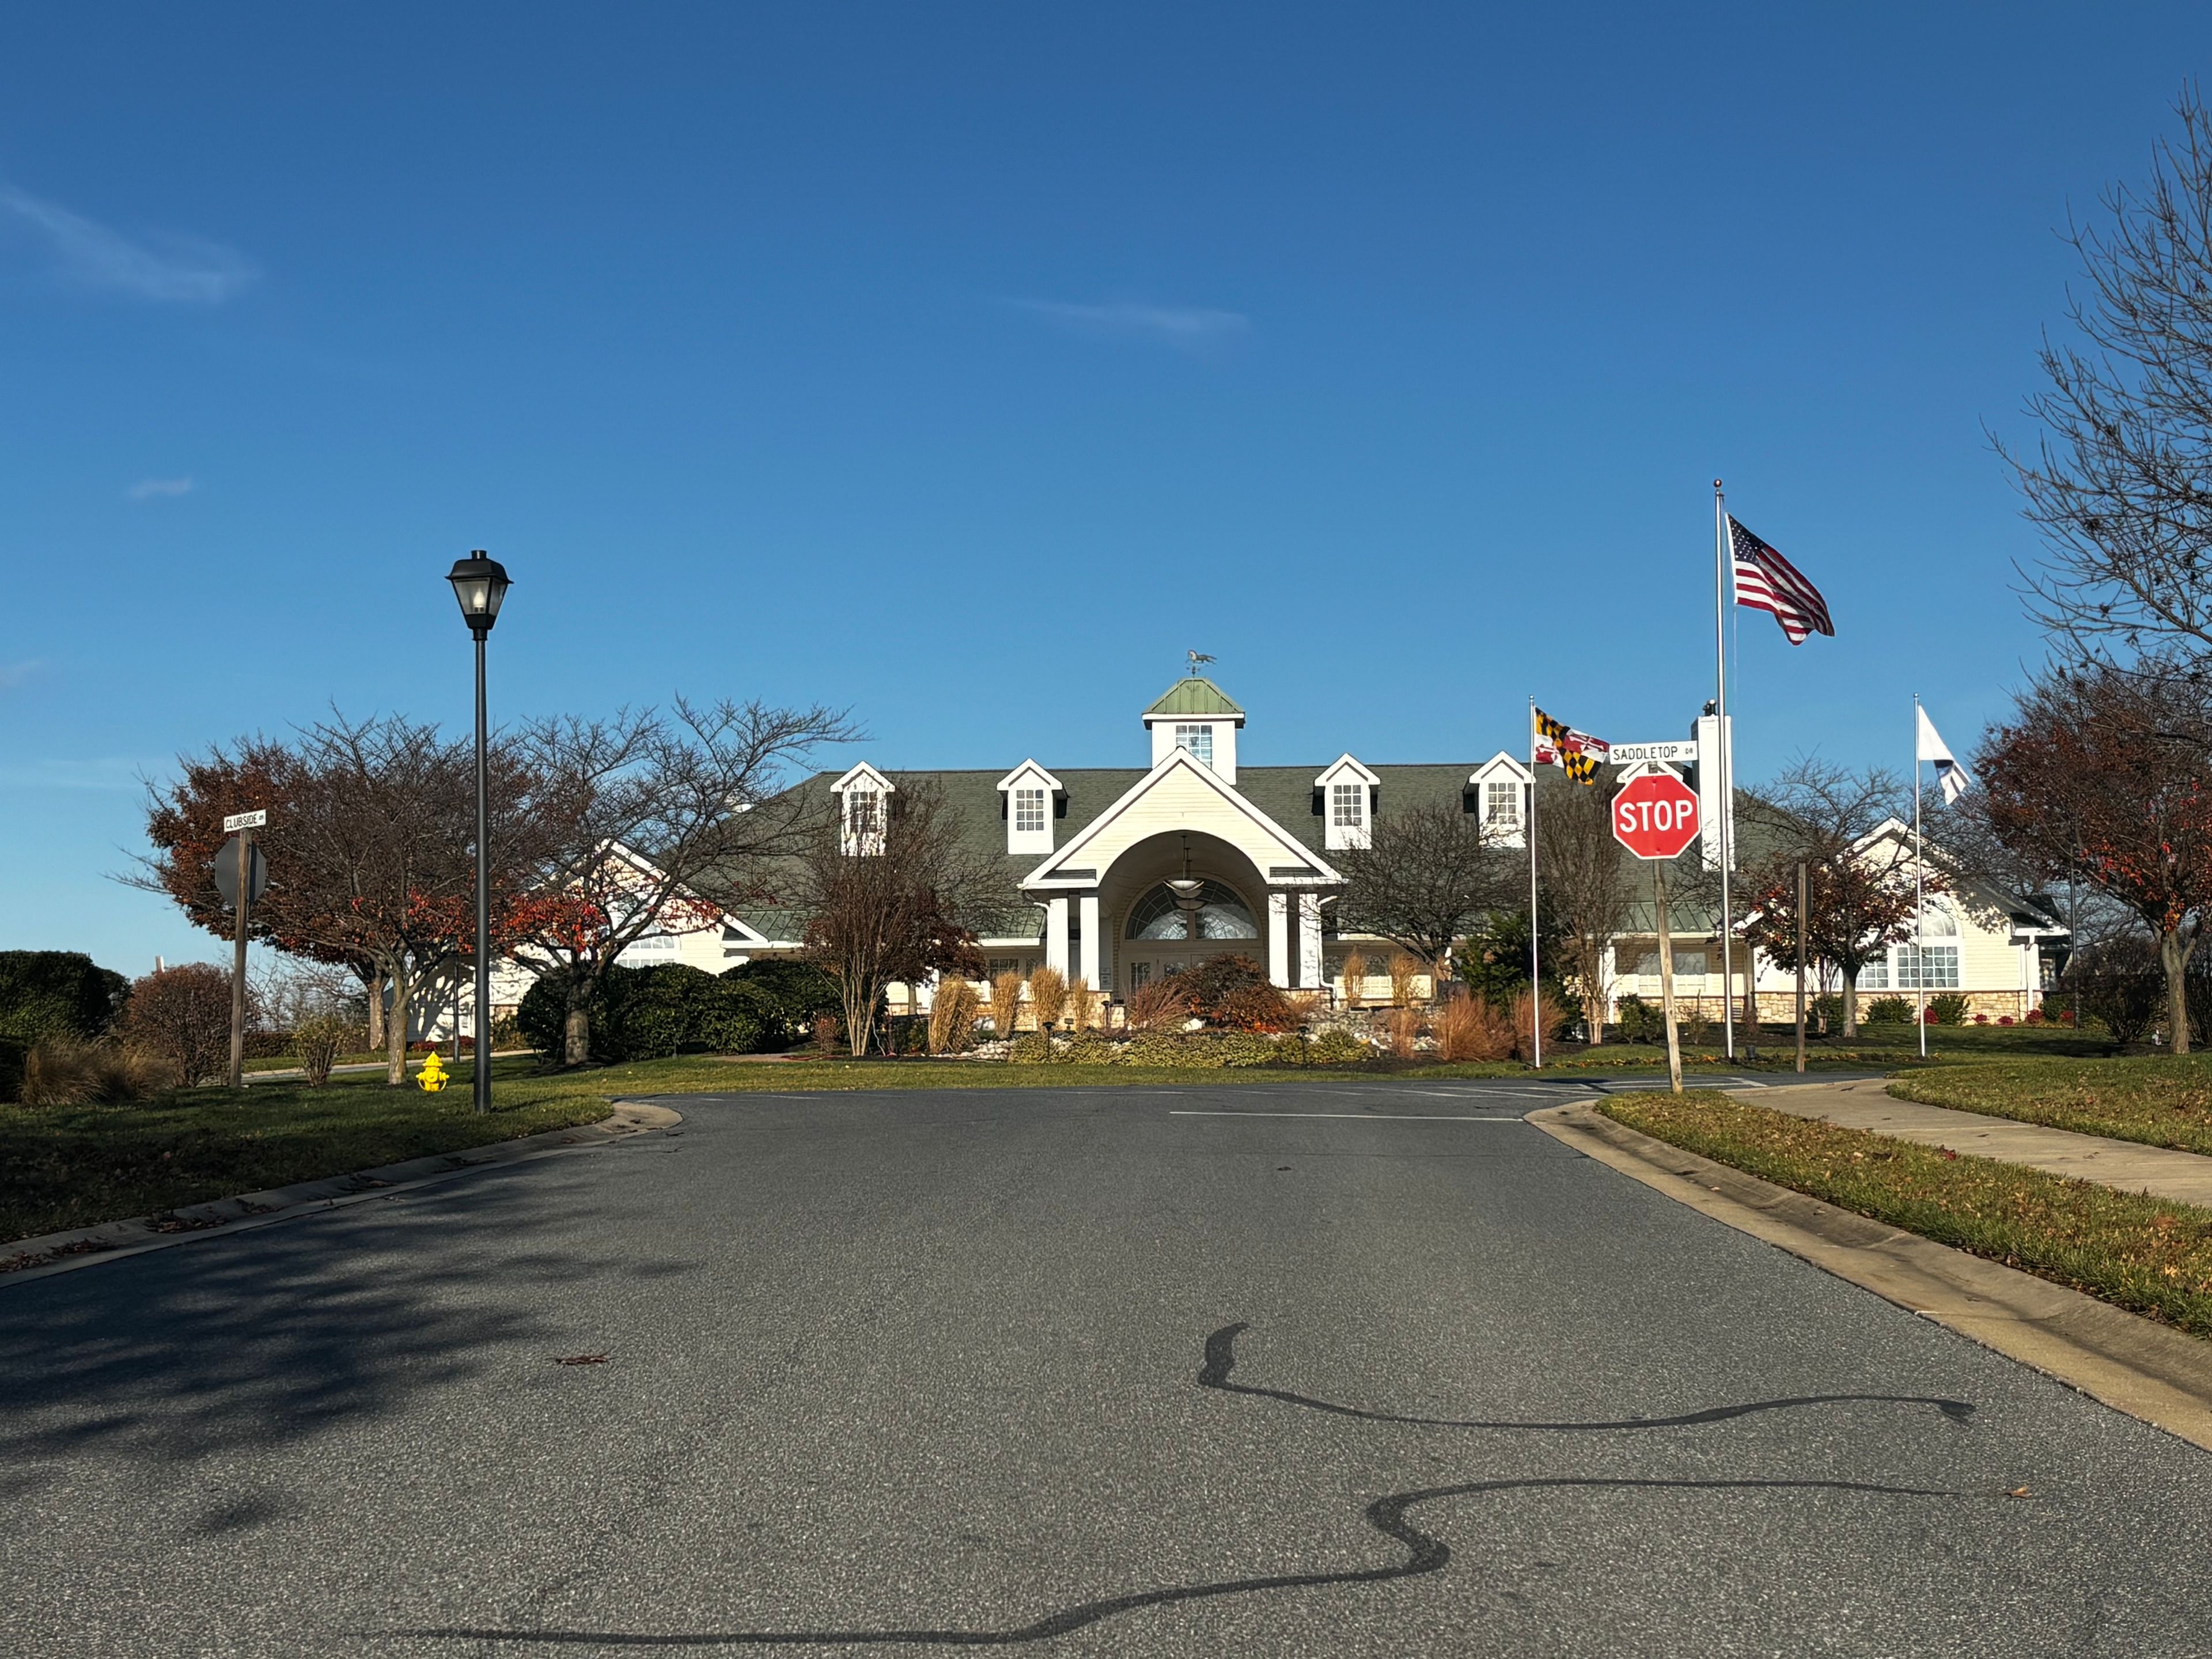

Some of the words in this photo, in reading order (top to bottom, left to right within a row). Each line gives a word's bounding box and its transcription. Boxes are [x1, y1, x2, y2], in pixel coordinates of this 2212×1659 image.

[1613, 746, 1677, 760] SADDLETOP
[226, 814, 257, 828] CLUBSIDE
[1620, 800, 1693, 832] STOP
